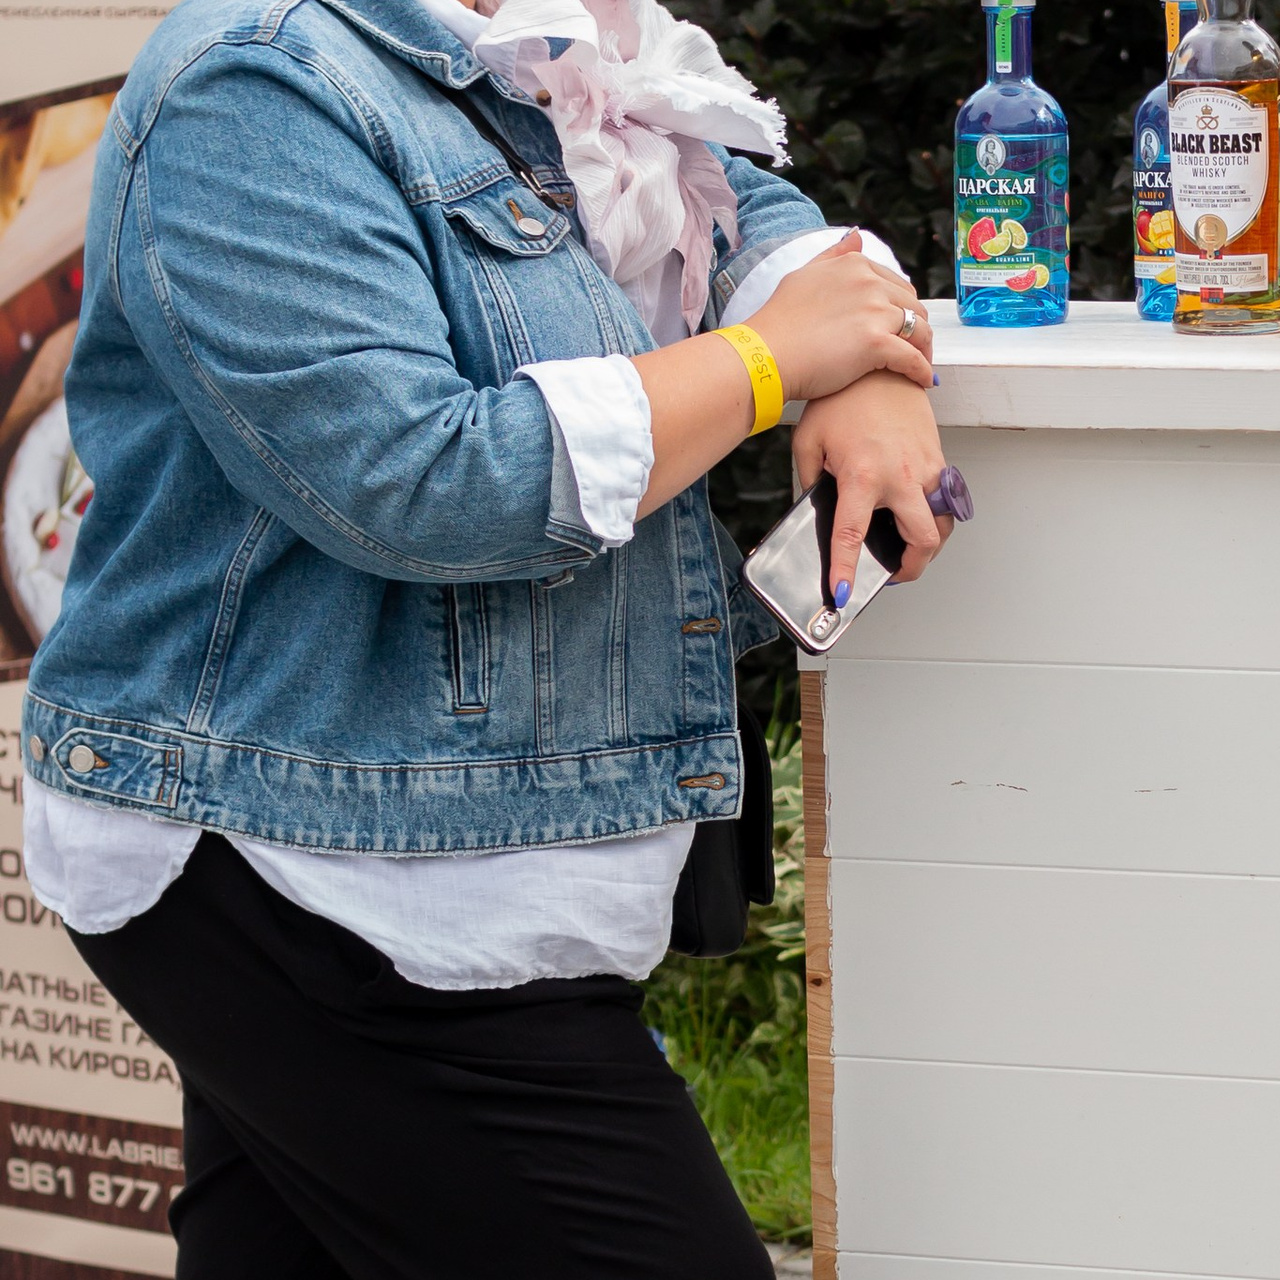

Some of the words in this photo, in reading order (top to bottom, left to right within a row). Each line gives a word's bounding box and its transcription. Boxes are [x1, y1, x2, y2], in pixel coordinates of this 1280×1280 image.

[1171, 132, 1205, 154] BLACK
[1209, 132, 1262, 154] BEAST
[1177, 154, 1210, 166] BLENDED
[1212, 155, 1249, 166] SCOTCH
[1192, 167, 1227, 178] WHISKY
[958, 177, 1036, 197] ЦАРСКАЯ
[747, 346, 774, 384] fest
[6, 1157, 76, 1198] 961
[88, 1172, 160, 1213] 877
